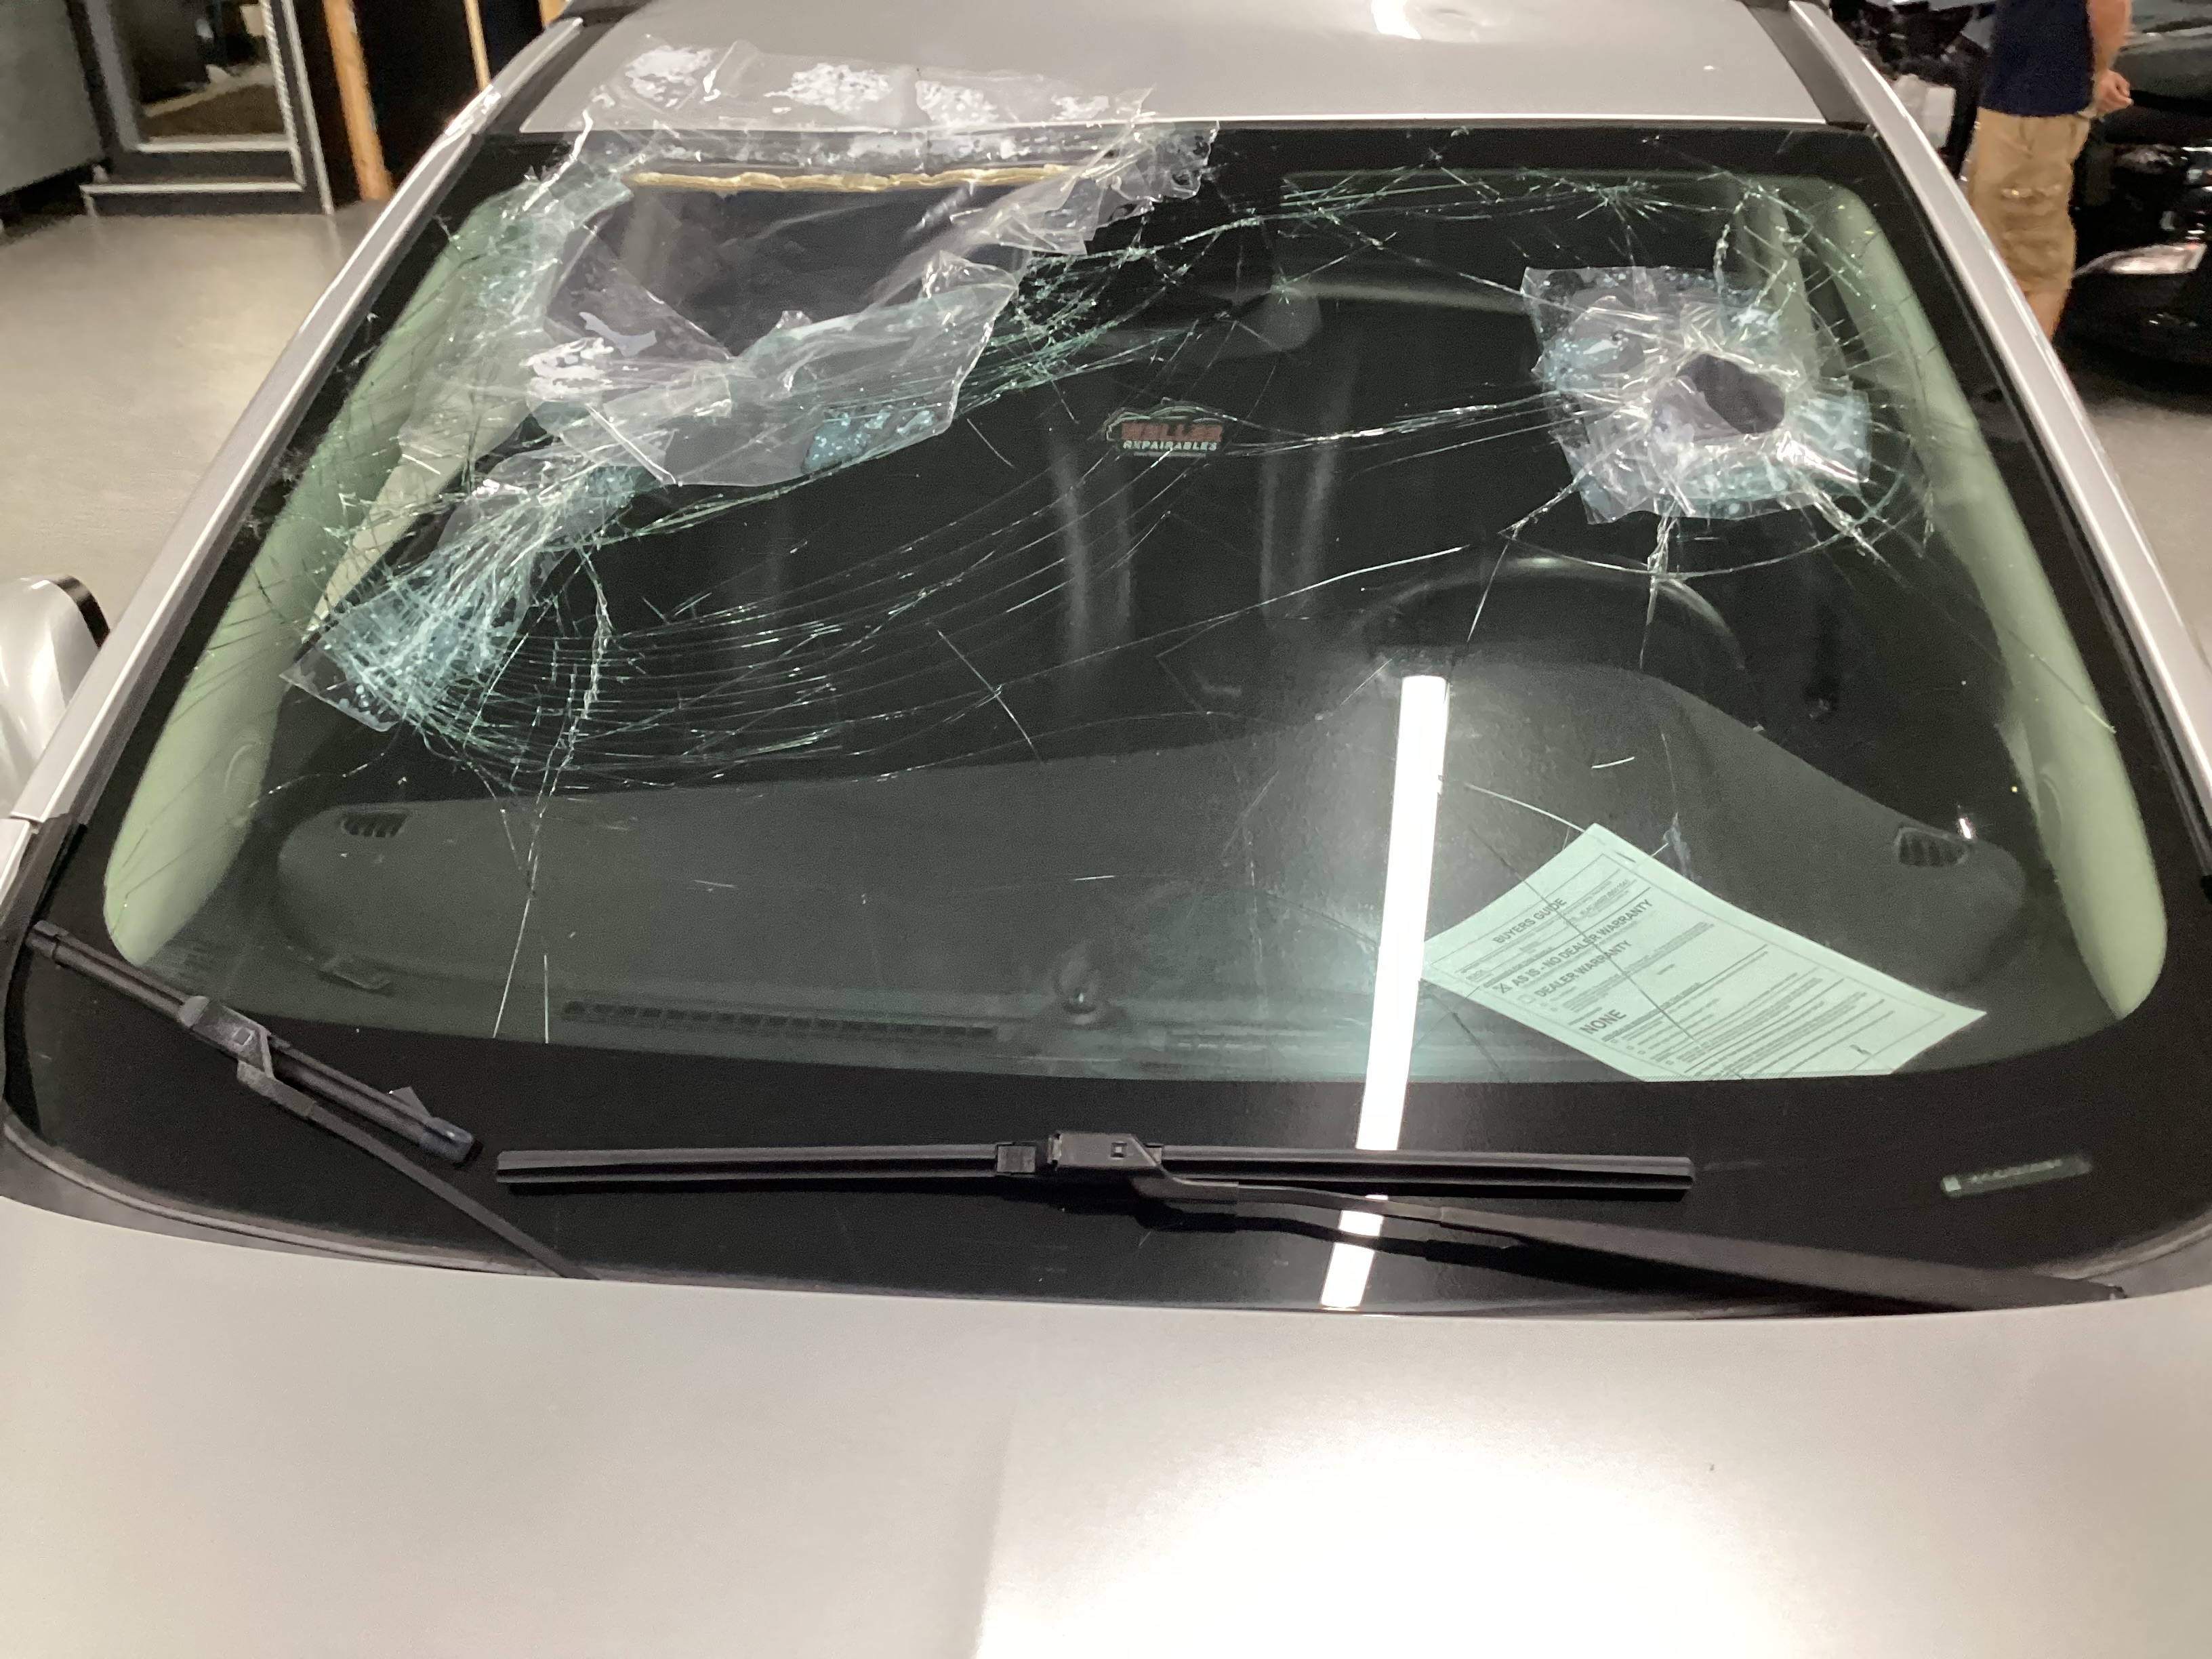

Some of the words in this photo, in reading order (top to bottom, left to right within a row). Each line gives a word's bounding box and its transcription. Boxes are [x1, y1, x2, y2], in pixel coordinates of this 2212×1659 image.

[1492, 918, 1536, 944] BUYERS
[1533, 898, 1568, 920] GUIDE
[1511, 975, 1526, 987] AS
[1528, 968, 1540, 978] IS
[1542, 956, 1562, 968] NO
[1559, 933, 1598, 960] DEALER
[1596, 899, 1653, 937] WARRANTY
[1534, 971, 1580, 998] DEALER
[1574, 939, 1632, 976] WARRANTY
[1579, 1008, 1627, 1035] NONE
